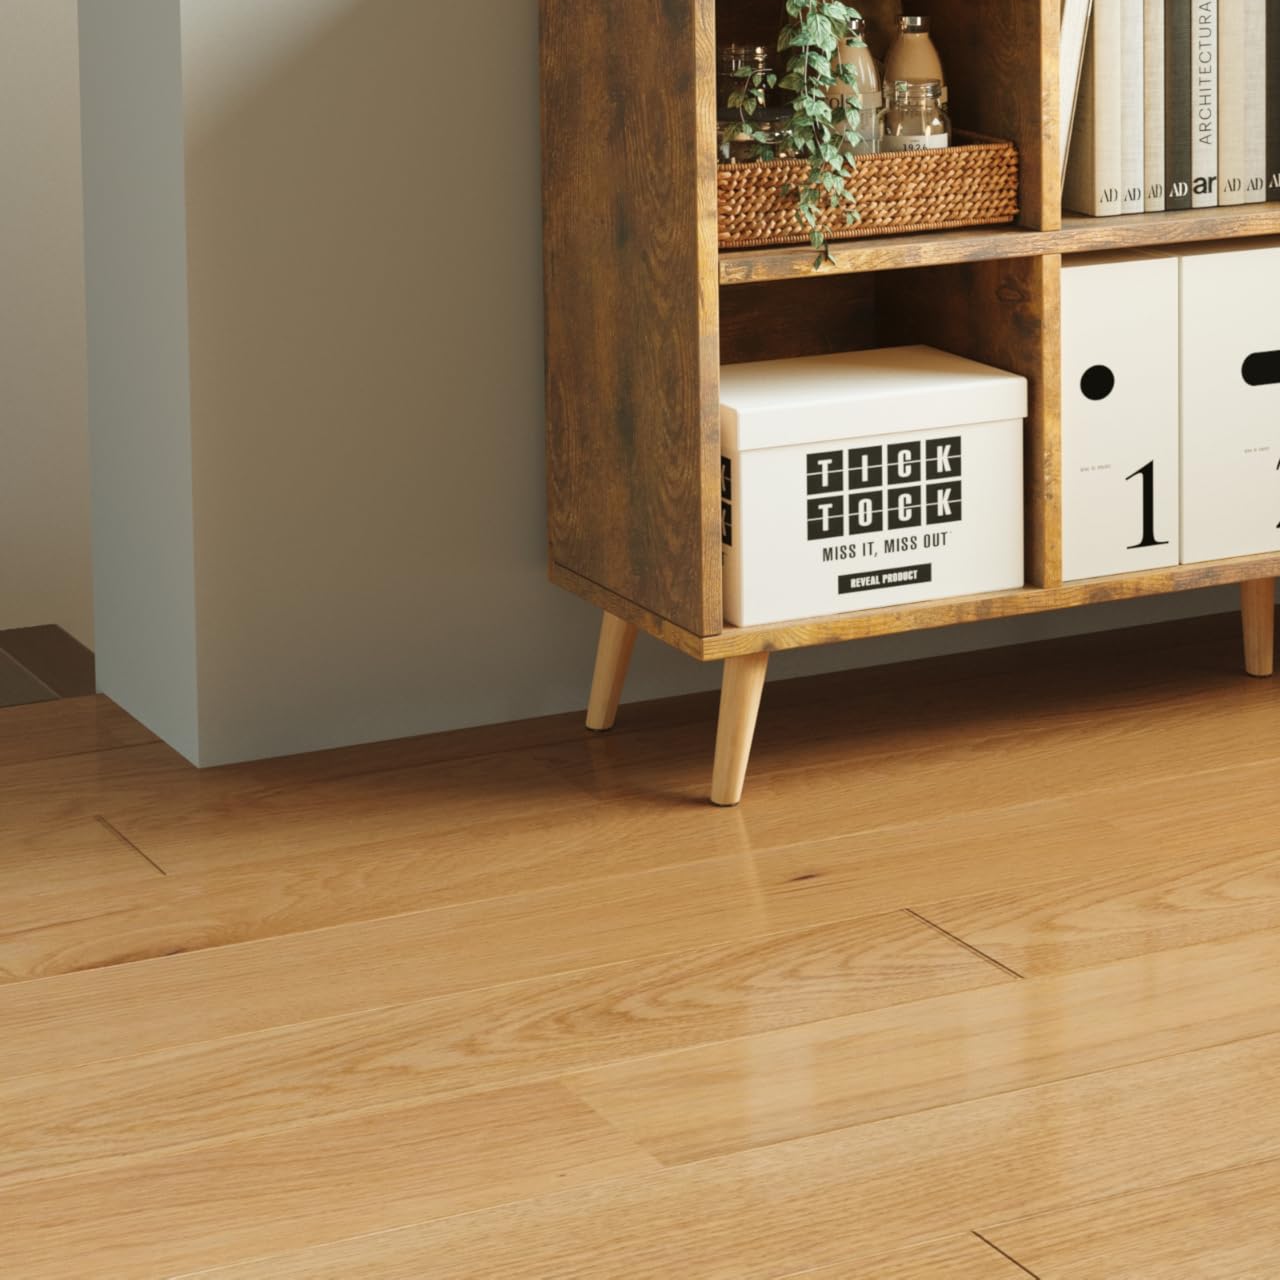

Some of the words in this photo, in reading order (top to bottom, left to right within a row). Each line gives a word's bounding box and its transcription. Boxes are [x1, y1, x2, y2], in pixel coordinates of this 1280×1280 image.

[1148, 183, 1163, 198] AD
[1169, 181, 1188, 197] AD
[1193, 175, 1217, 195] ar
[1223, 177, 1241, 192] AD
[1246, 176, 1263, 191] AD
[1099, 187, 1118, 203] AD
[1123, 186, 1141, 202] AD
[817, 444, 952, 488] TICK
[817, 488, 952, 532] TOCK
[1125, 460, 1169, 550] 1
[823, 544, 857, 562] MISS
[862, 541, 878, 558] IT,
[884, 536, 918, 554] MISS
[923, 531, 948, 549] OUT
[850, 572, 880, 589] REVEAL
[882, 569, 918, 586] PRODUCT
